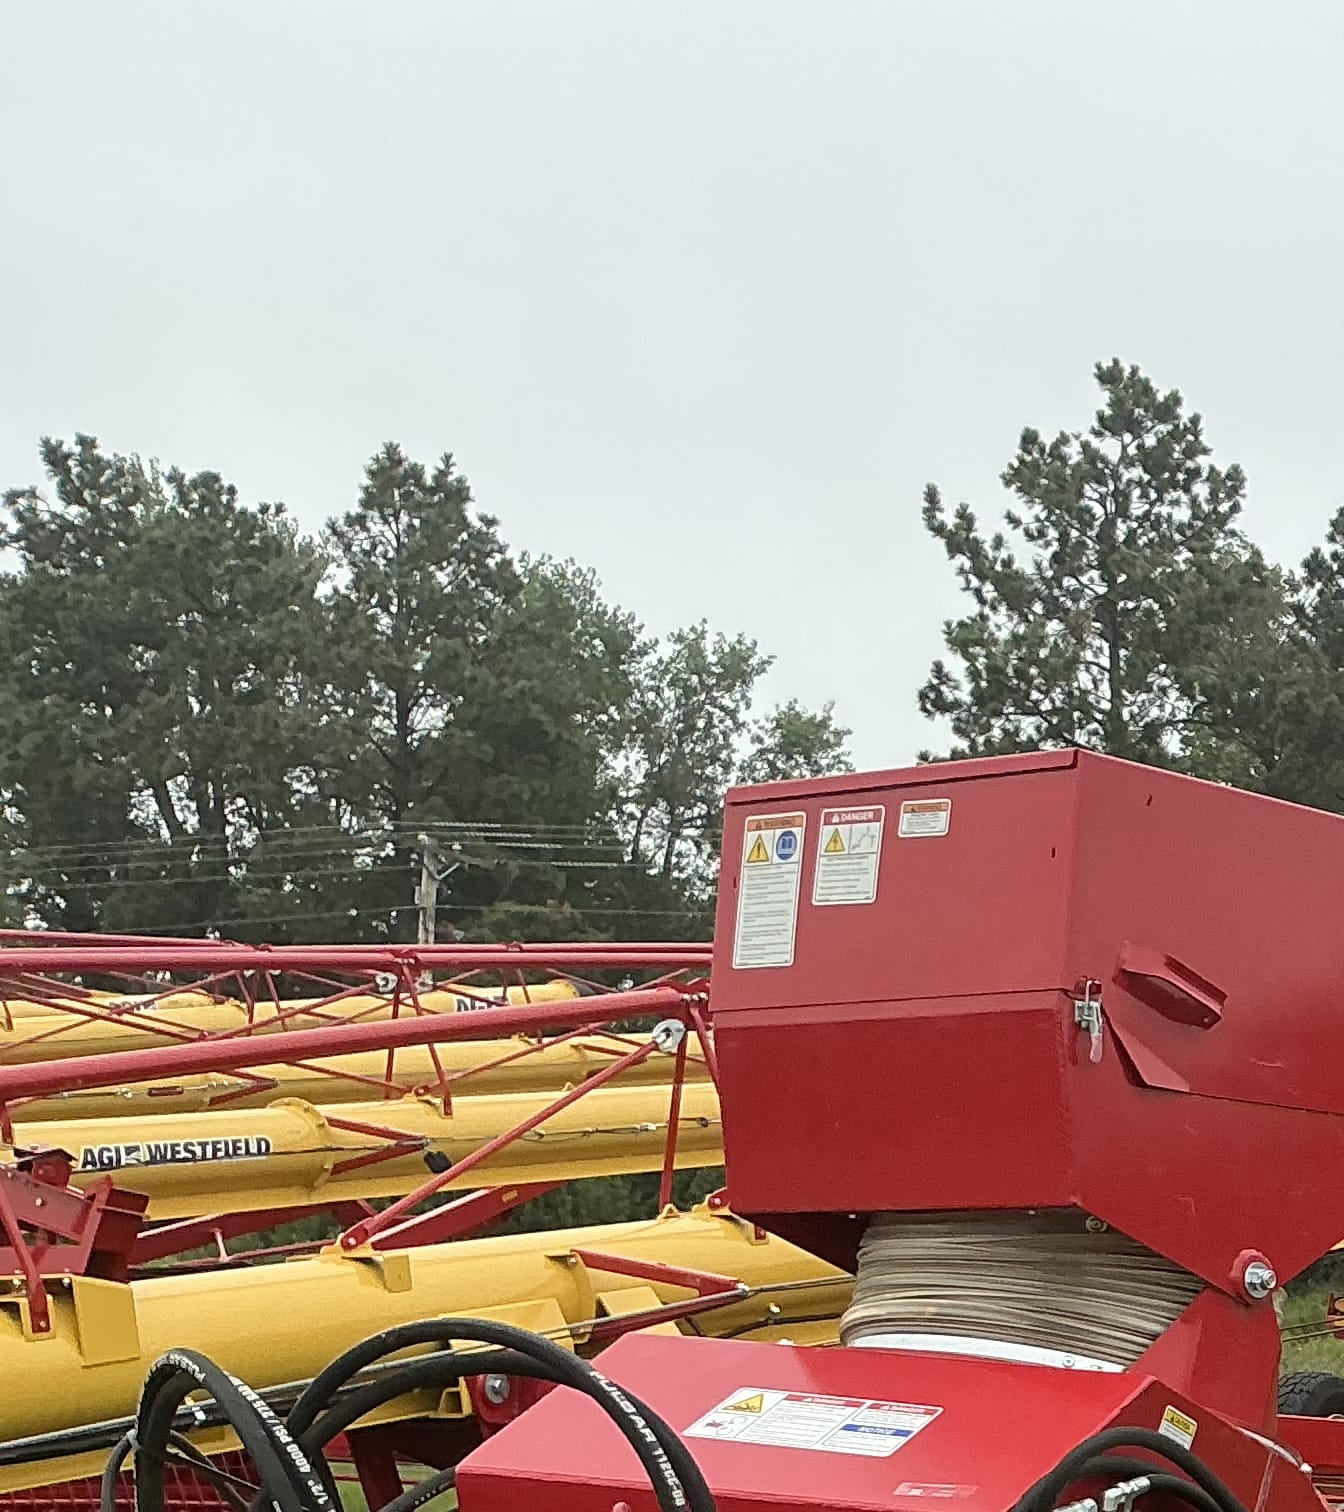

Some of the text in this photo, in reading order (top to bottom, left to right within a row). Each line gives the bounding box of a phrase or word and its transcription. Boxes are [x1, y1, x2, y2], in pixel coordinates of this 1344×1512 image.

[839, 812, 873, 821] DANGER
[81, 1138, 271, 1169] AGI WESTFIELD
[252, 1399, 275, 1419] 275
[272, 1424, 293, 1444] PSI
[286, 1444, 311, 1473] 4000
